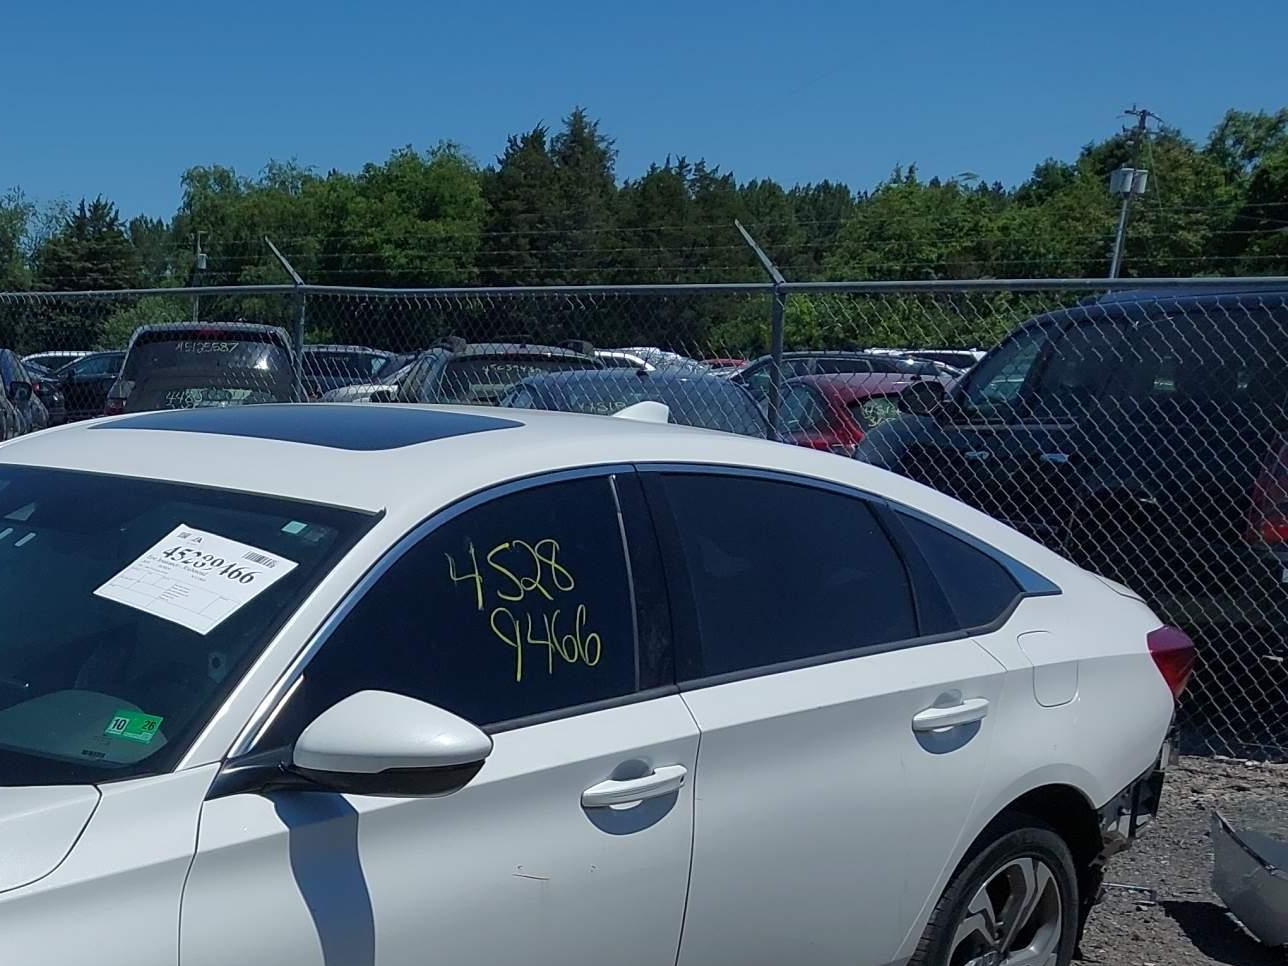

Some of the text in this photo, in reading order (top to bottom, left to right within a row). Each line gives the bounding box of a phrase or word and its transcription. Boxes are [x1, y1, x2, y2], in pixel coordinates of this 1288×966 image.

[162, 545, 263, 585] 45289466
[444, 538, 575, 610] 4528
[490, 603, 601, 682] 9466
[112, 718, 157, 731] 10 26
